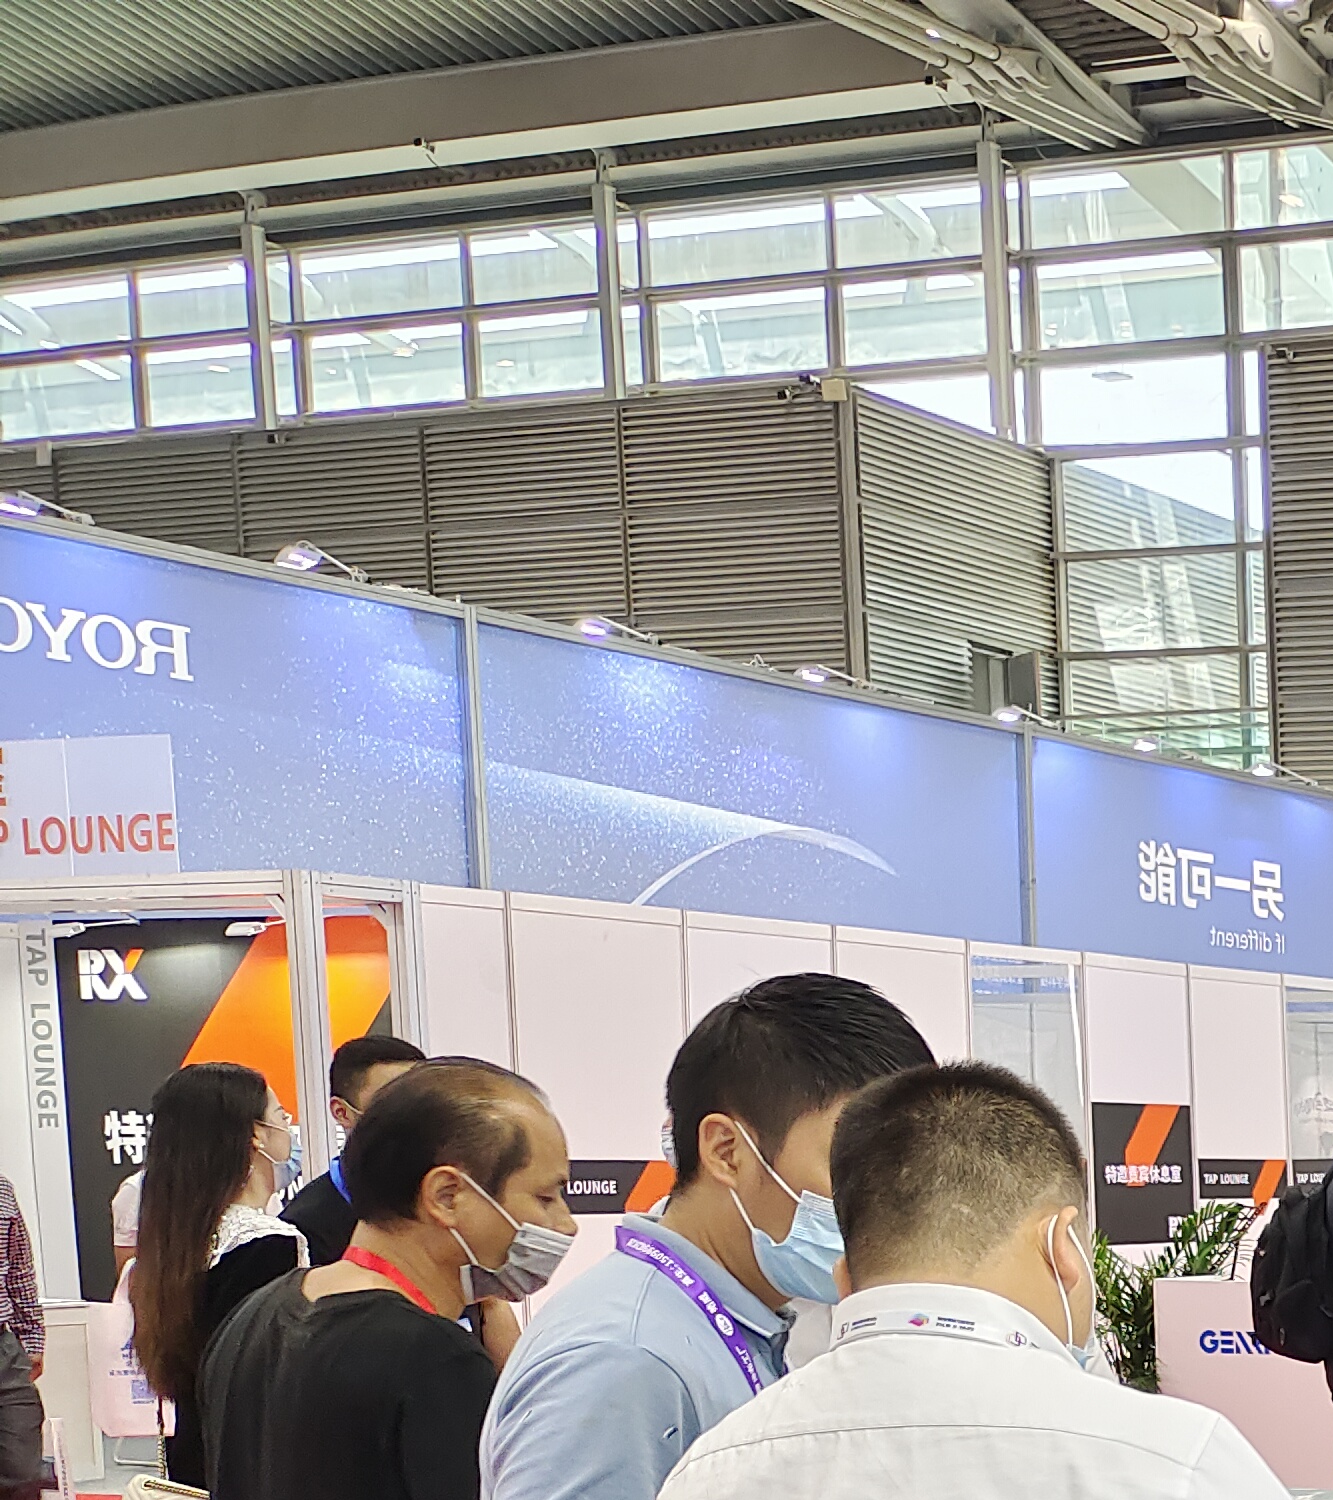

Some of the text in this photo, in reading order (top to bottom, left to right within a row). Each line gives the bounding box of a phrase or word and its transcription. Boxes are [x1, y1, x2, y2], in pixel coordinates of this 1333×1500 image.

[22, 813, 176, 855] LOUNGE
[26, 927, 59, 1130] TAP LOUNGE
[566, 1179, 617, 1195] LOUNGE
[1203, 1173, 1250, 1186] TAP LOUNGE
